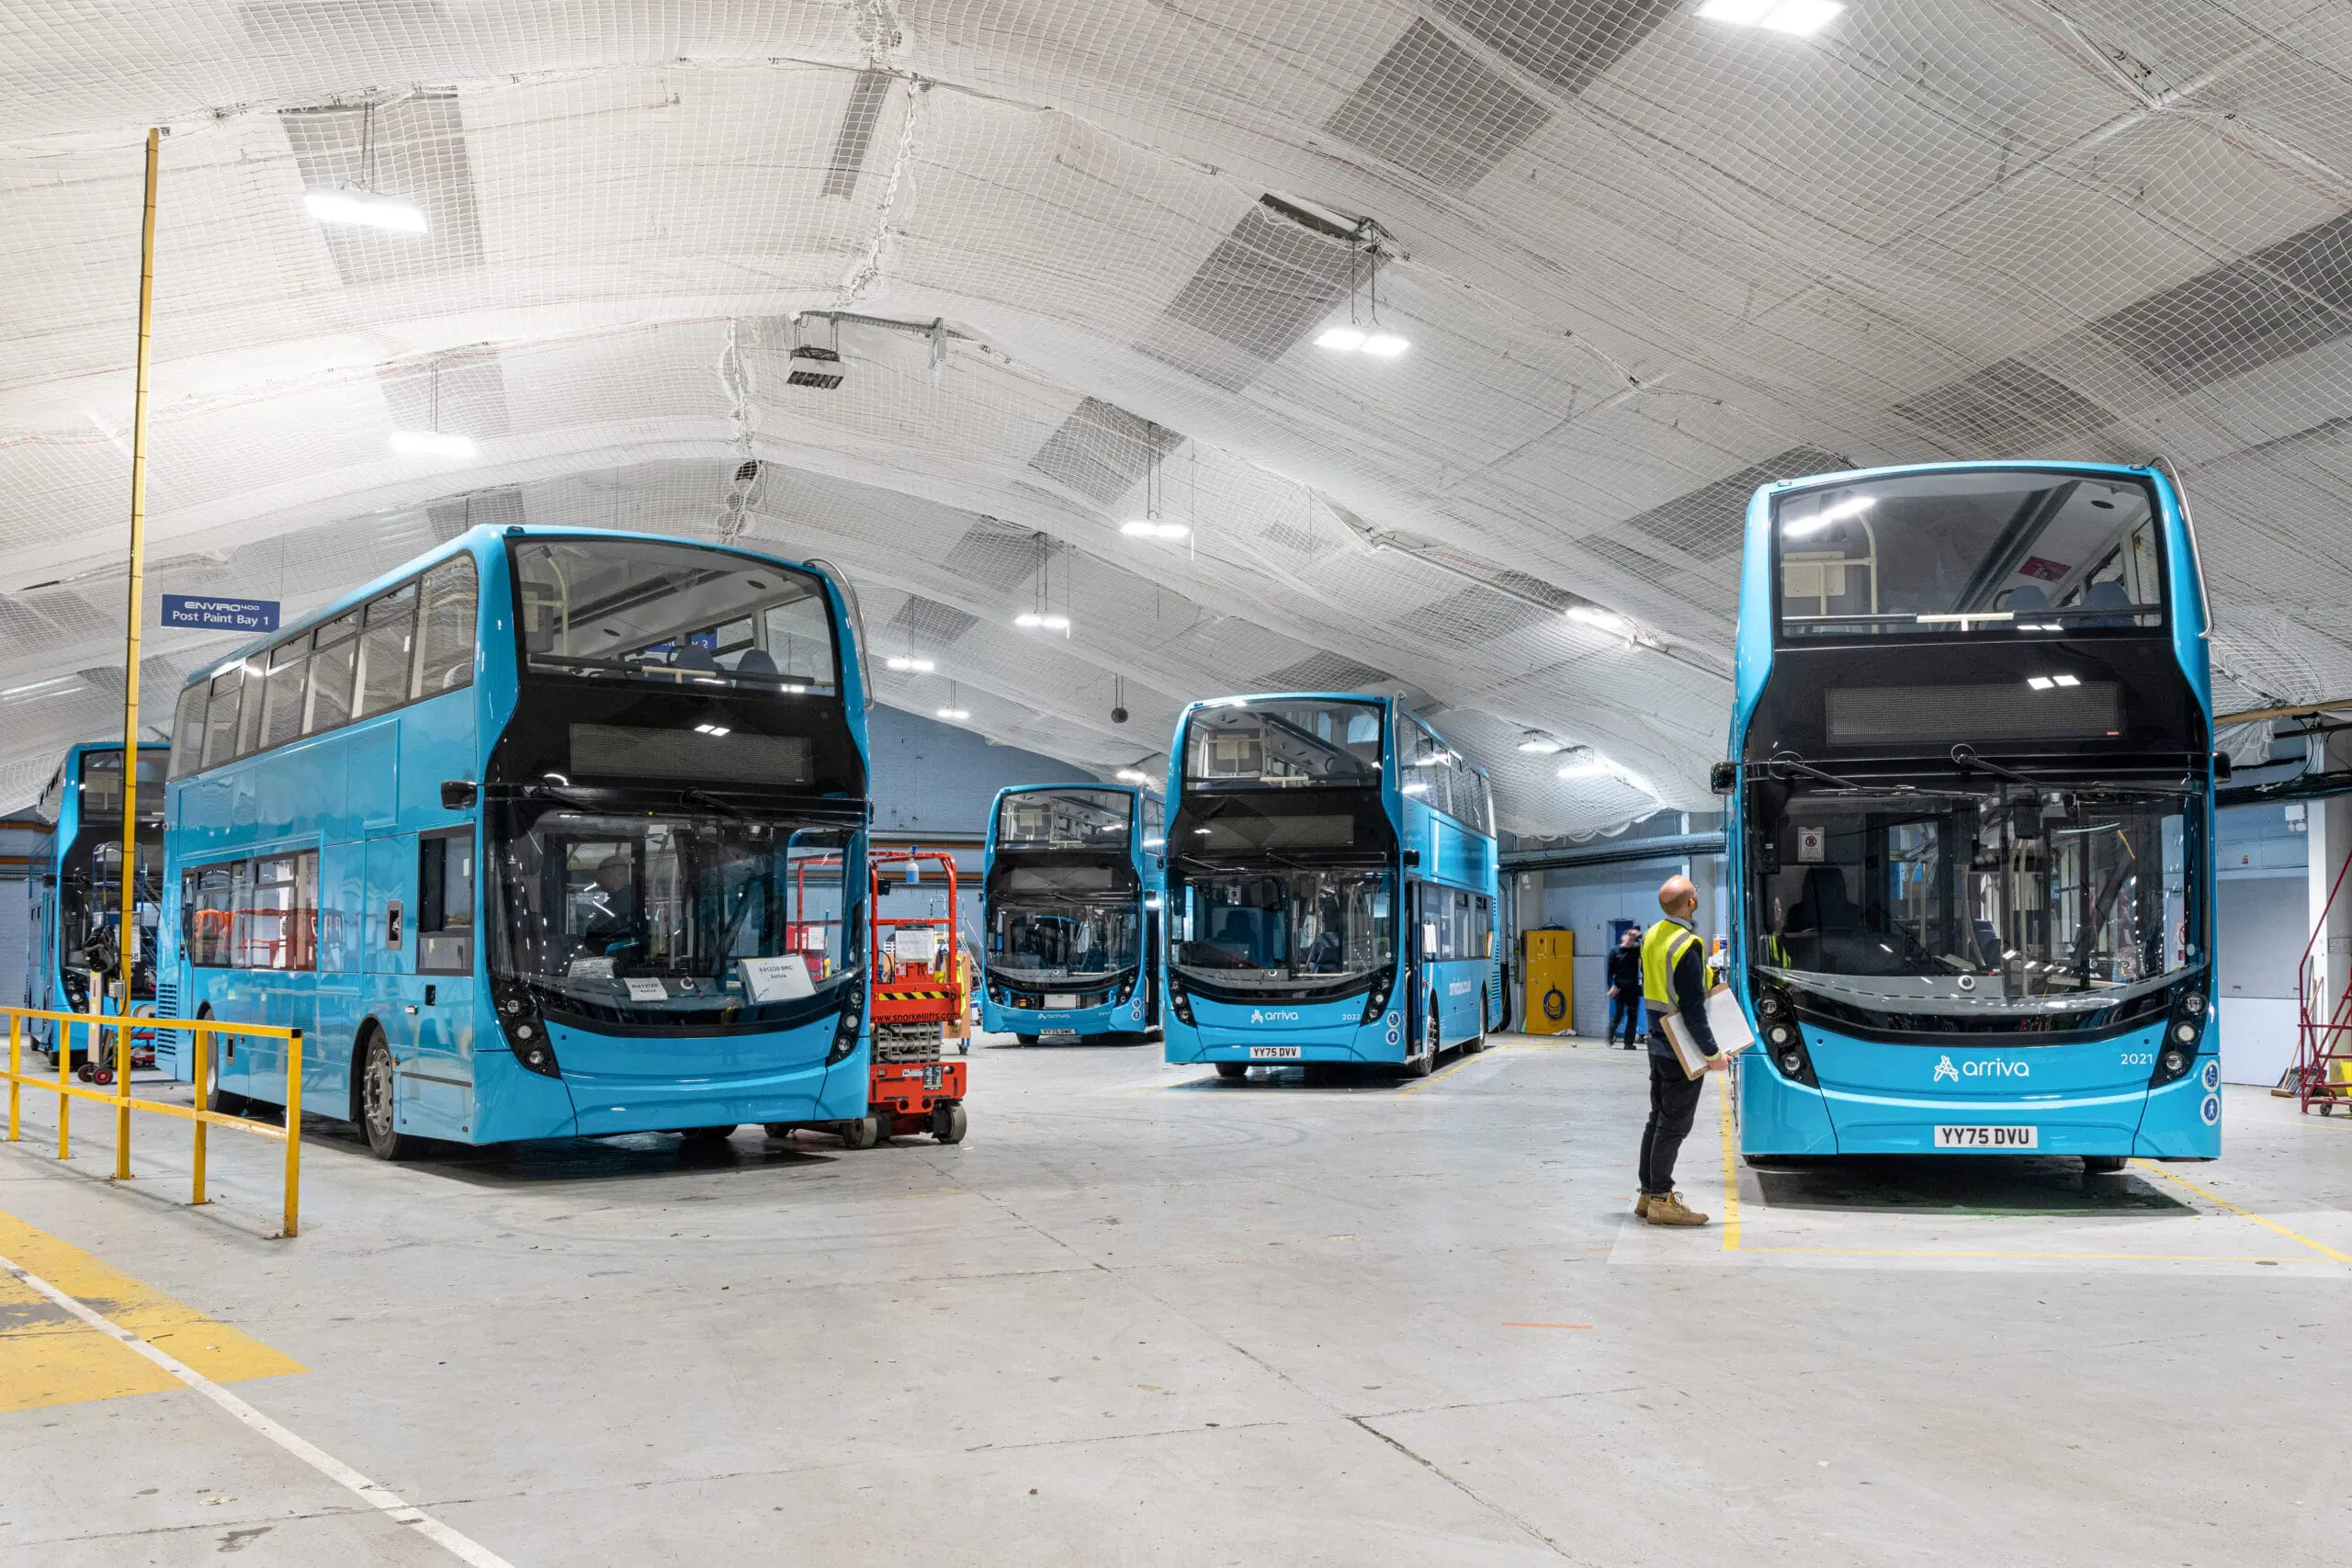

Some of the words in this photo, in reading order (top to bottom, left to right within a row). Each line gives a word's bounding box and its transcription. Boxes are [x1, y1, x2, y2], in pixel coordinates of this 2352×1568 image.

[173, 611, 198, 621] Post
[203, 613, 232, 624] Paint
[237, 615, 258, 626] Bay
[264, 616, 269, 625] 1
[1265, 1010, 1298, 1021] arriva
[1253, 1048, 1277, 1056] YY75
[1279, 1048, 1296, 1056] DVV
[2120, 1054, 2153, 1065] 2021
[1962, 1057, 2030, 1077] arriva
[1942, 1128, 1989, 1145] YY75
[1995, 1128, 2030, 1145] DVU
